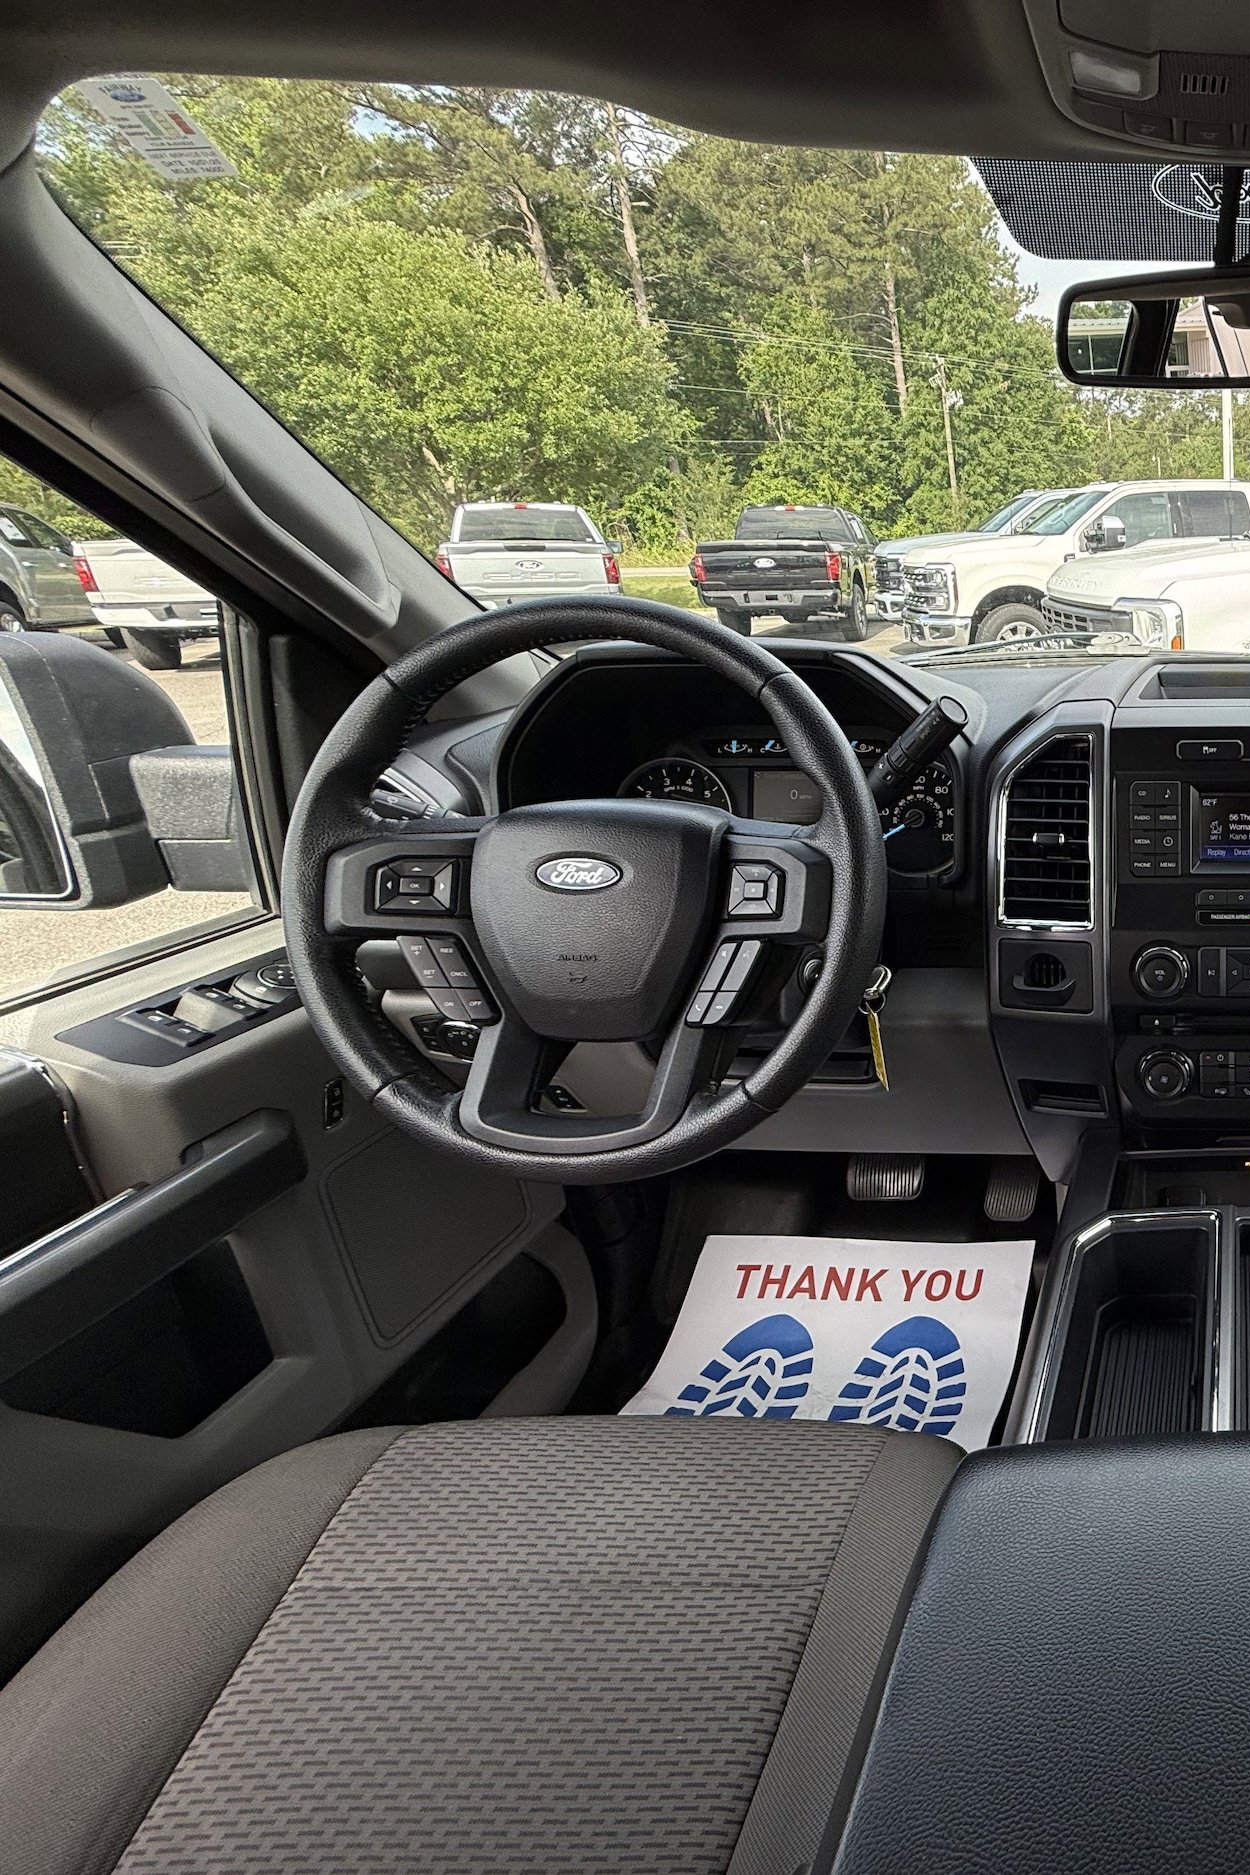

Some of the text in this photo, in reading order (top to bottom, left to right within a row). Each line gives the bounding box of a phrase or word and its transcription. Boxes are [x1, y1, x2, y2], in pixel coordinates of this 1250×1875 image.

[663, 777, 671, 786] 3
[685, 777, 693, 786] 4
[645, 790, 652, 798] 2
[703, 790, 711, 798] 5
[934, 786, 949, 794] 80
[1228, 813, 1239, 821] 56
[1229, 832, 1248, 841] Kane
[1207, 848, 1227, 857] Replay
[1233, 848, 1250, 856] Direct
[550, 860, 605, 884] Ford
[736, 1264, 985, 1302] THANK YOU
